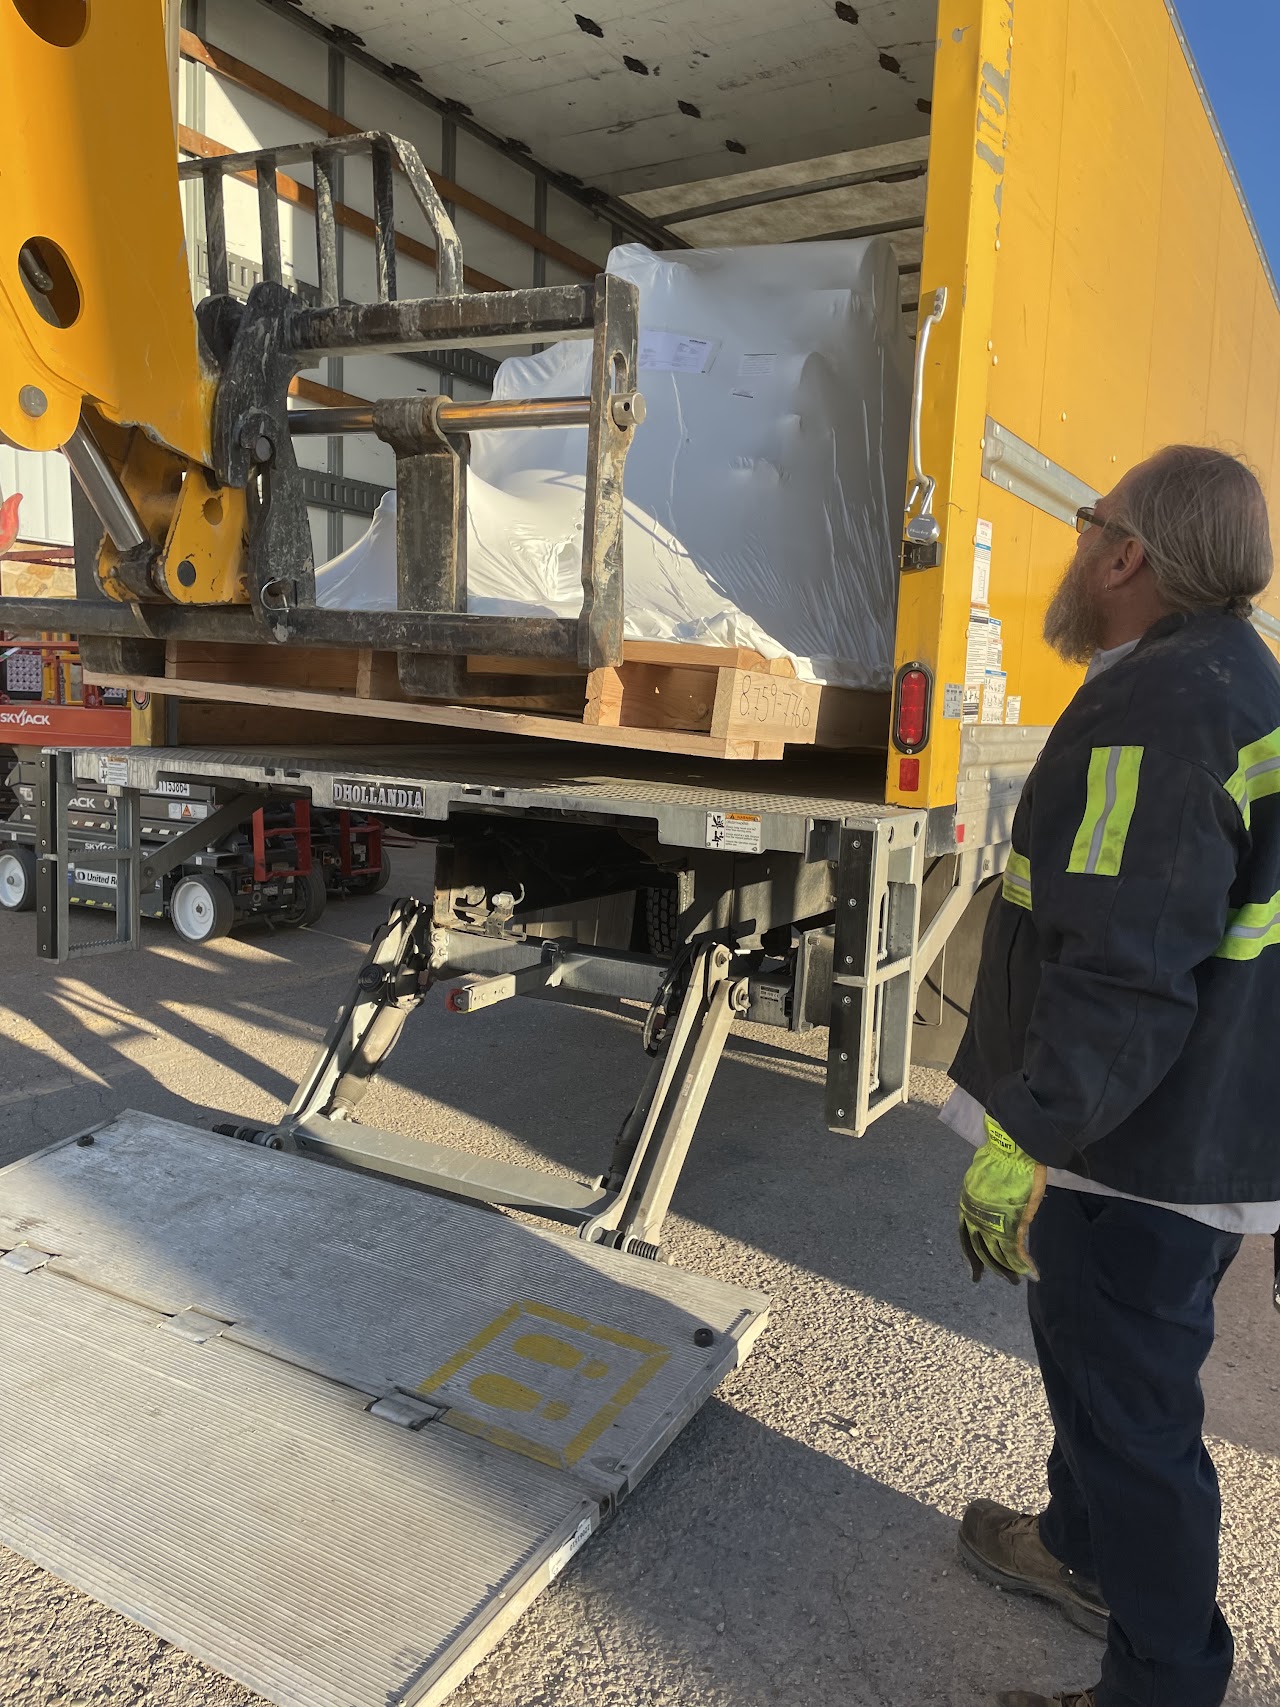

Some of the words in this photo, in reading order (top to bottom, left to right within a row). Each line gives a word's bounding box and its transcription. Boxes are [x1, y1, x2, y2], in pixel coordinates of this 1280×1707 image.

[0, 709, 51, 727] SKYJACK
[68, 797, 96, 809] ACK
[333, 783, 423, 810] DHOLLANDIA
[87, 872, 110, 884] United
